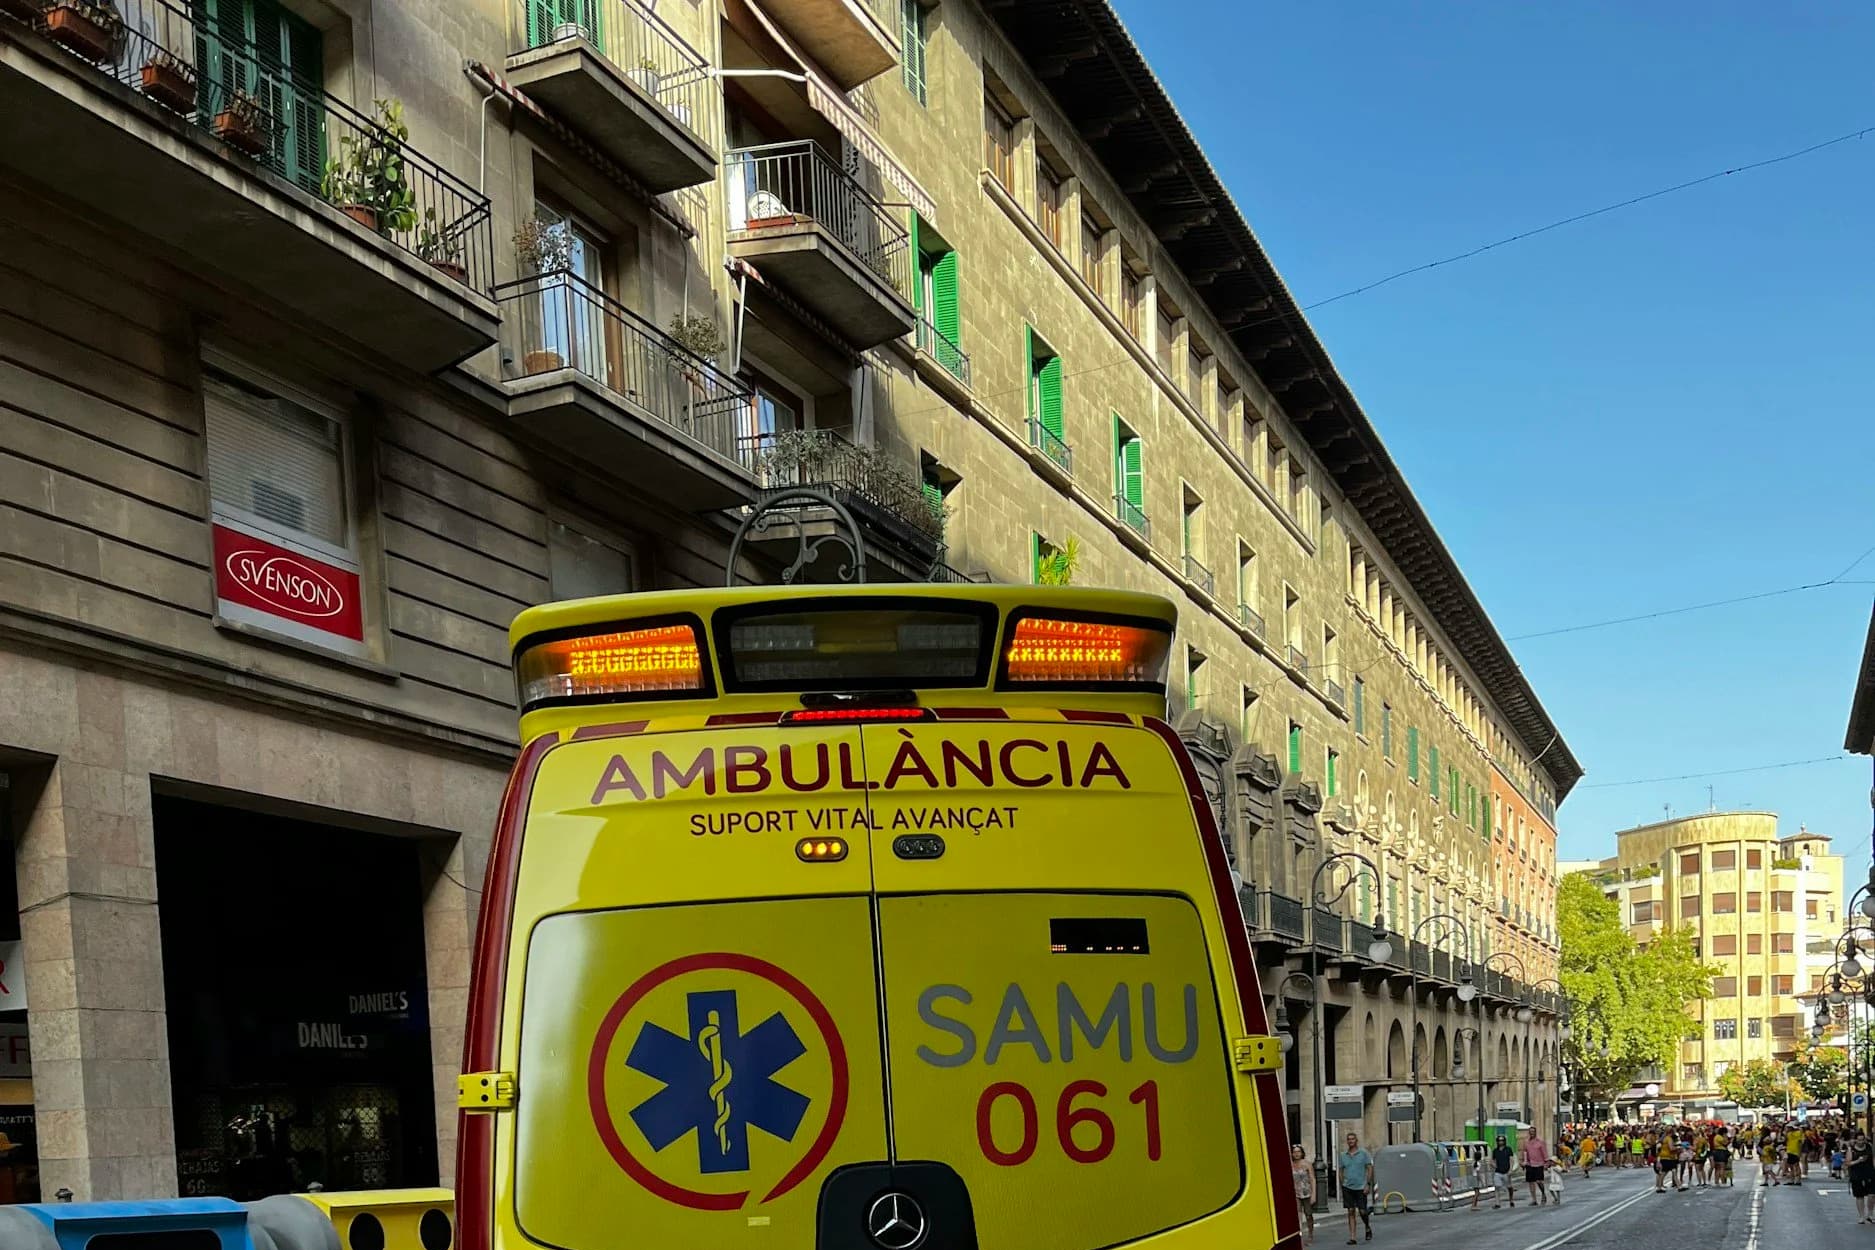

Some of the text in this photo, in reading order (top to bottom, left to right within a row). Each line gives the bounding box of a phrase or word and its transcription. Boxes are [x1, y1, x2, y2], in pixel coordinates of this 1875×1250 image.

[240, 558, 331, 609] SVENSON
[590, 727, 1132, 805] AMBULÀNCIA
[690, 807, 1019, 836] SUPORT VITAL AVANÇAT
[348, 991, 409, 1014] DANIEL'S
[916, 981, 1200, 1069] SAMU
[976, 1079, 1162, 1167] 061
